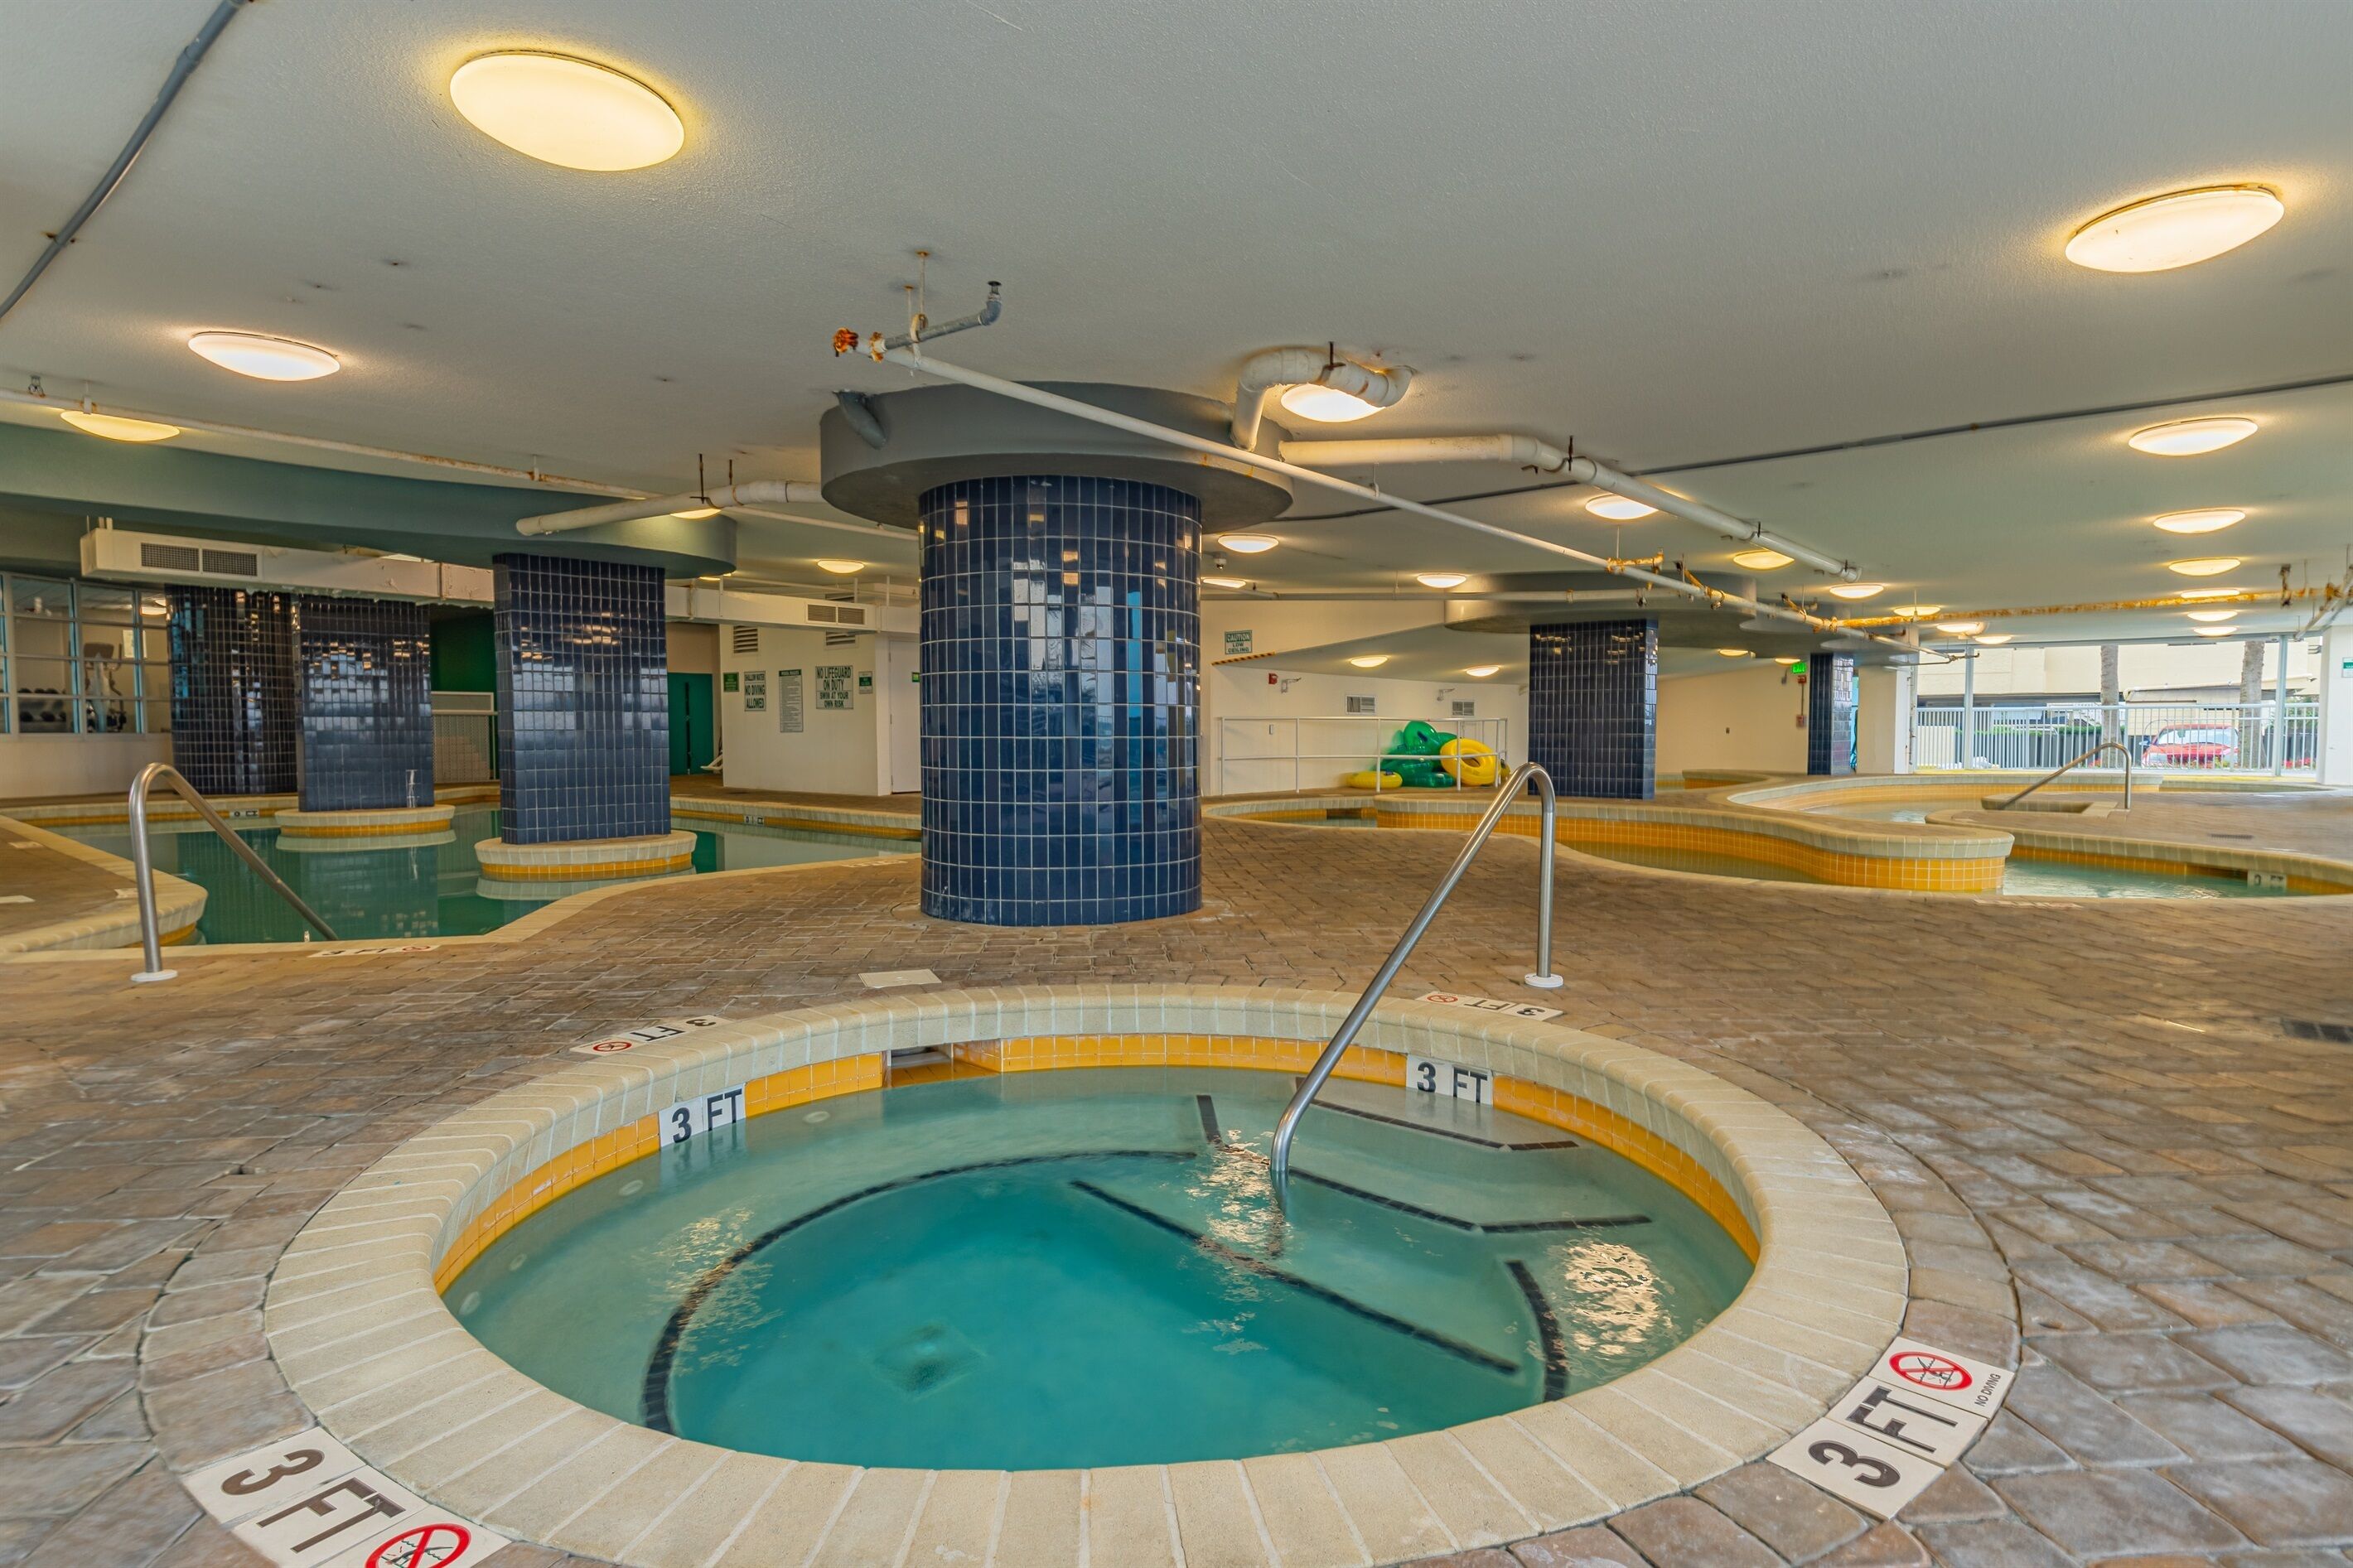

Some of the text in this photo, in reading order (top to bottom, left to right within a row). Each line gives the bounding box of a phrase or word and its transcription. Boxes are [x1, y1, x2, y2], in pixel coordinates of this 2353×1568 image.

[1227, 632, 1250, 642] CAUTION
[817, 667, 852, 678] NO LIFEGUARD
[745, 684, 766, 695] NO DIVING
[824, 679, 844, 691] ON DUTY
[820, 691, 848, 700] SWIM AT YOUR
[746, 697, 765, 709] ALLOWED
[824, 700, 844, 708] OWN RISK
[1463, 999, 1545, 1016] 3 FT
[629, 1018, 717, 1042] 3 FT
[1417, 1061, 1488, 1103] 3 FT
[671, 1088, 742, 1144] 3 FT
[1974, 1373, 2002, 1407] NO DIVING
[1808, 1385, 1959, 1488] 3 FT
[221, 1448, 407, 1553] 3 FT
